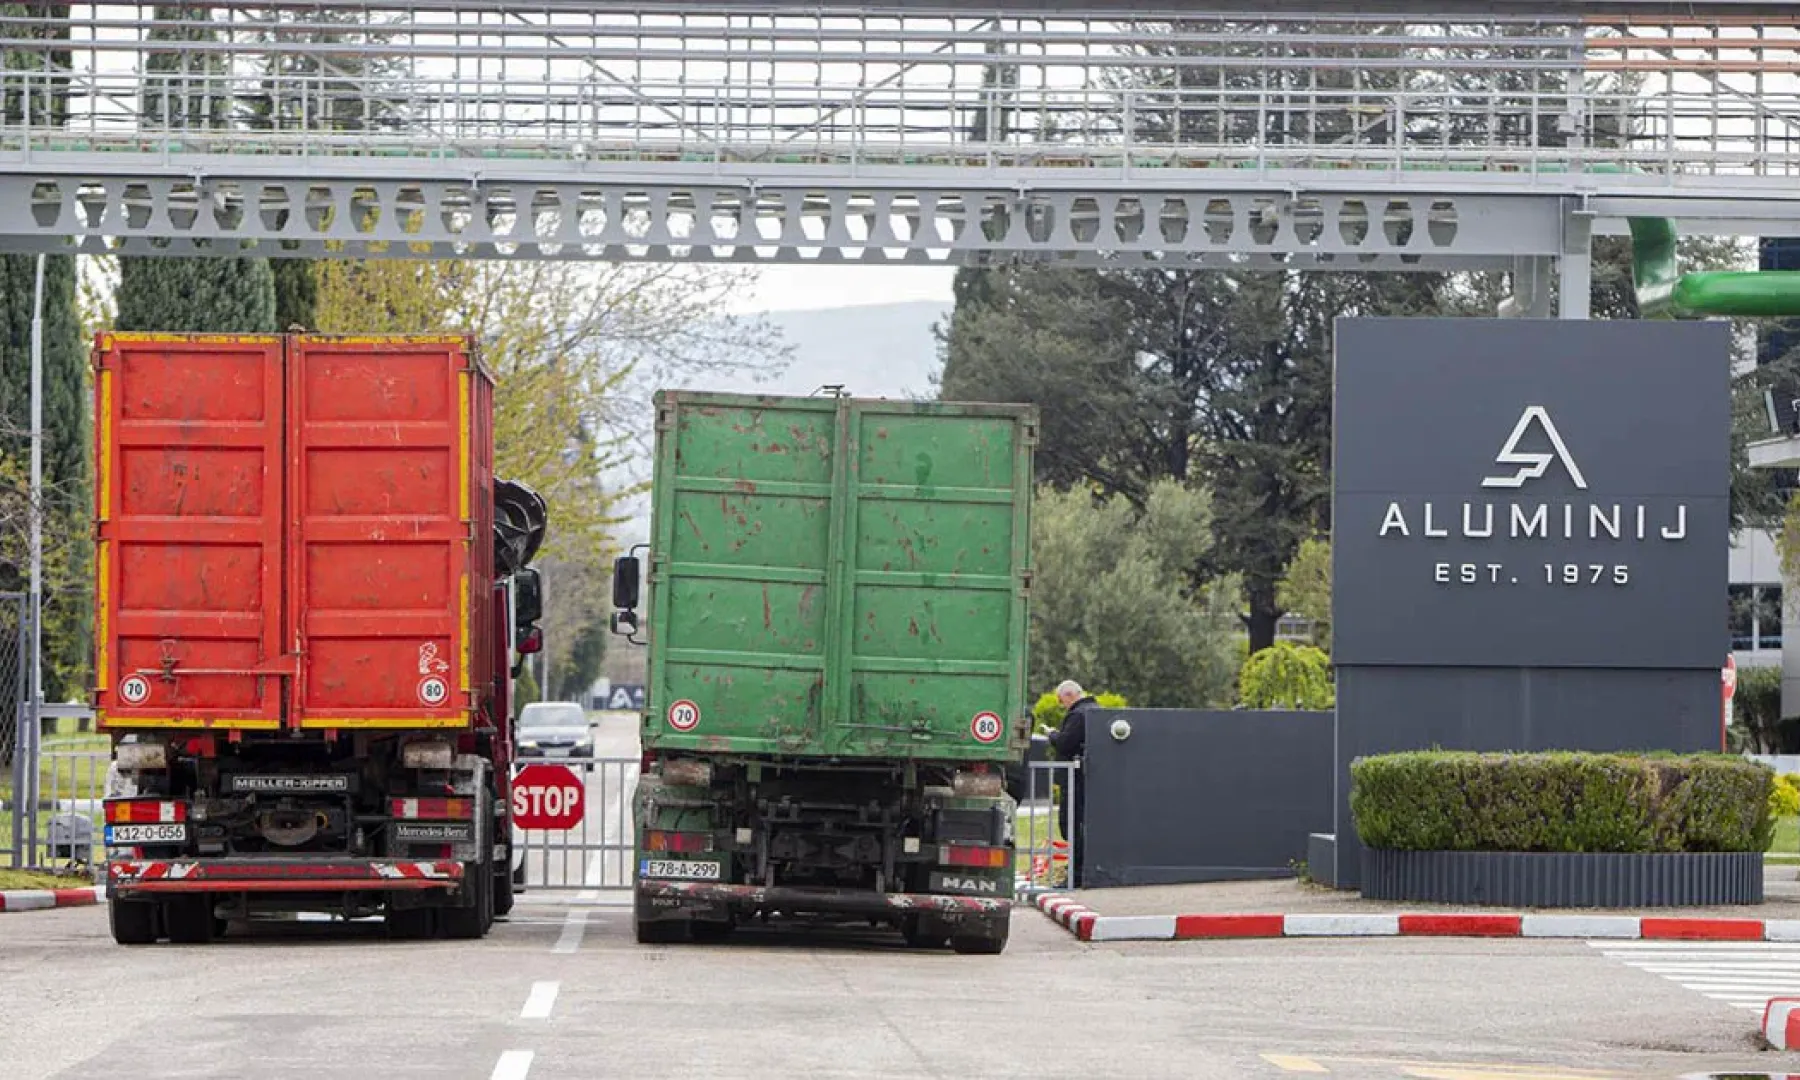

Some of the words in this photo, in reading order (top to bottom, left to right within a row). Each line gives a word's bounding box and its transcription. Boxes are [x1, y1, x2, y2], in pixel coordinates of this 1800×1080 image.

[1379, 502, 1687, 539] ALUMINIJ
[1434, 563, 1518, 583] EST.
[1544, 563, 1628, 584] 1975
[127, 683, 143, 696] 70
[425, 684, 441, 697] 80
[677, 709, 692, 722] 70
[980, 721, 995, 733] 80
[513, 785, 579, 816] STOP
[398, 825, 468, 837] Mercedes-Benz
[649, 862, 718, 877] E78-A-299
[942, 877, 997, 892] MAN
